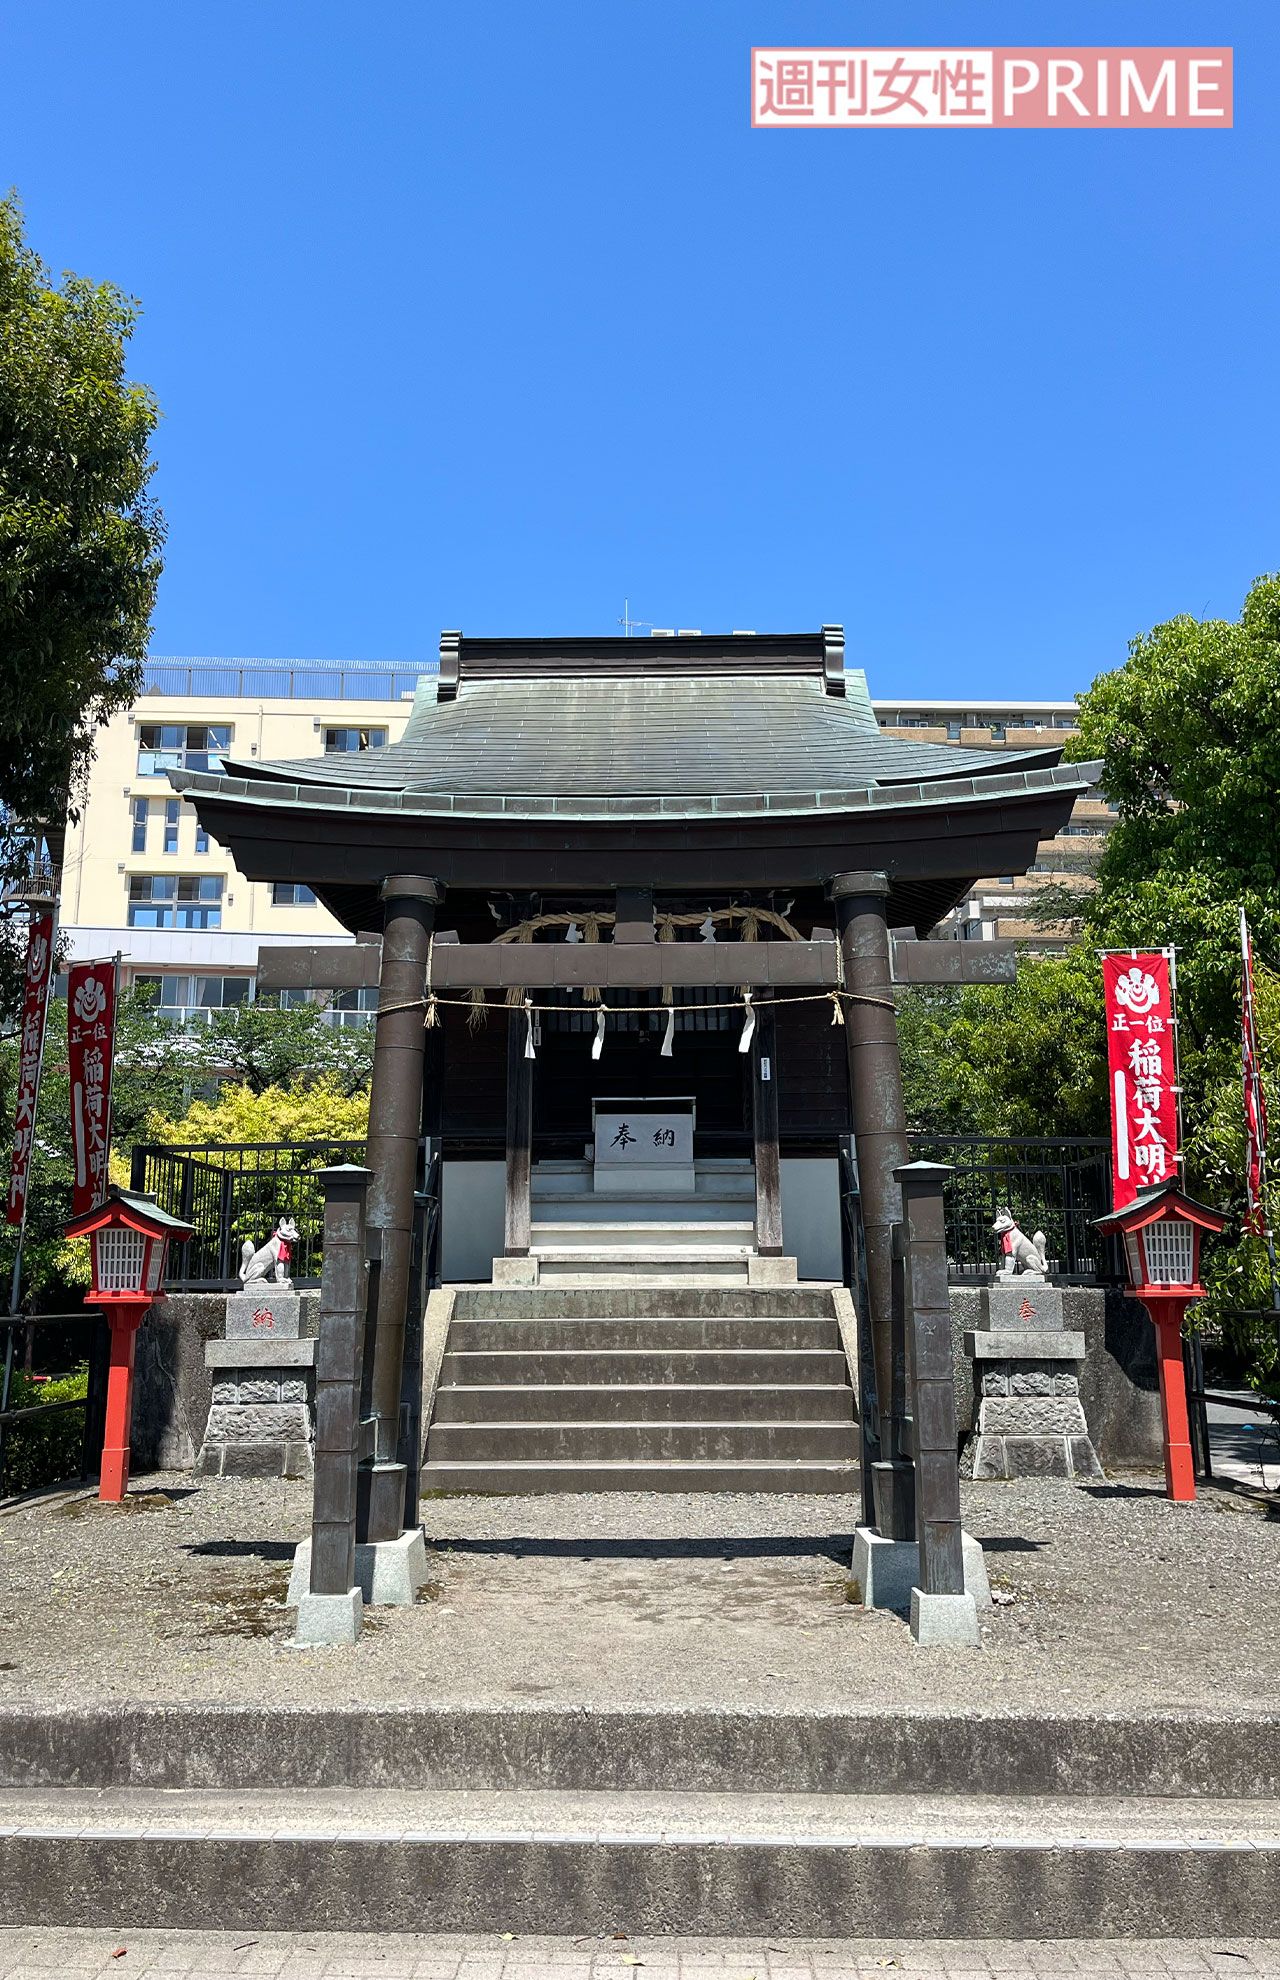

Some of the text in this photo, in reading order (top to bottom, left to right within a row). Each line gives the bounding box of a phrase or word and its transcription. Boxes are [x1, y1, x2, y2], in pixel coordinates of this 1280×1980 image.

[70, 1022, 108, 1044] 正一位
[1111, 1013, 1166, 1034] 正一位
[1128, 1038, 1168, 1188] 稲荷大明
[609, 1122, 676, 1150] 奉納
[1018, 1297, 1037, 1321] 奉
